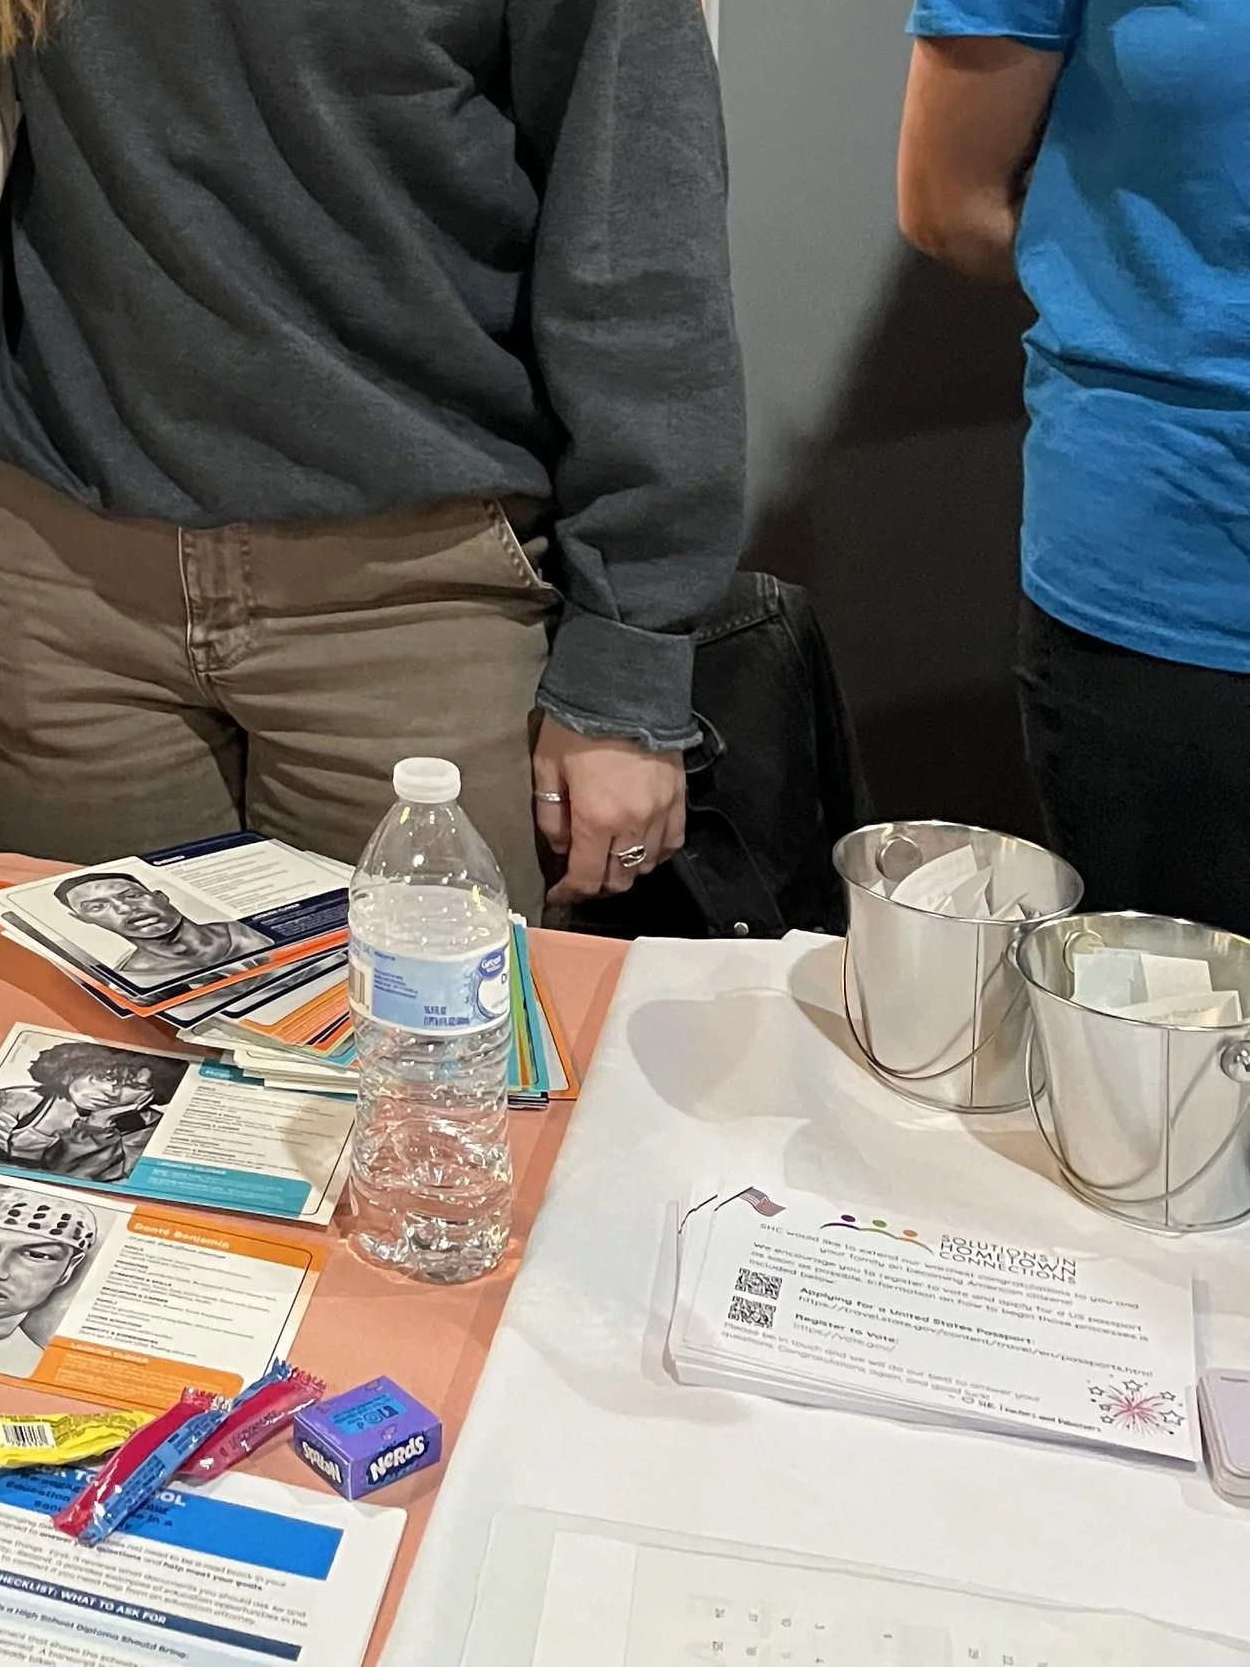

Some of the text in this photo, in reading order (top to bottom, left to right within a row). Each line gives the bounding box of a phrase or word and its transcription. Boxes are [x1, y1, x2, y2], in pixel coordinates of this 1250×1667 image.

[940, 1242, 1077, 1277] HOMETOWN
[942, 1234, 1048, 1263] SOLUTIONS
[939, 1251, 1077, 1285] CONNECTIONS
[800, 1287, 852, 1305] Applying
[856, 1300, 873, 1309] for
[889, 1308, 929, 1322] United
[932, 1318, 972, 1332] States
[1087, 1316, 1141, 1331] passport
[723, 1321, 759, 1335] Please
[761, 1331, 776, 1339] be
[777, 1335, 789, 1344] in
[791, 1339, 822, 1351] touch
[824, 1348, 846, 1359] and
[849, 1354, 865, 1362] we
[867, 1359, 885, 1367] will
[795, 1313, 896, 1342] Register to Vote:
[162, 1561, 184, 1571] help
[185, 1568, 210, 1578] meet
[212, 1574, 233, 1583] your
[60, 1590, 95, 1605] WHAT
[98, 1599, 114, 1610] TO
[115, 1605, 139, 1617] ASK
[141, 1611, 166, 1623] FOR
[14, 1607, 38, 1619] High
[40, 1614, 74, 1628] School
[76, 1623, 118, 1640] Diploma
[120, 1635, 157, 1650] Should
